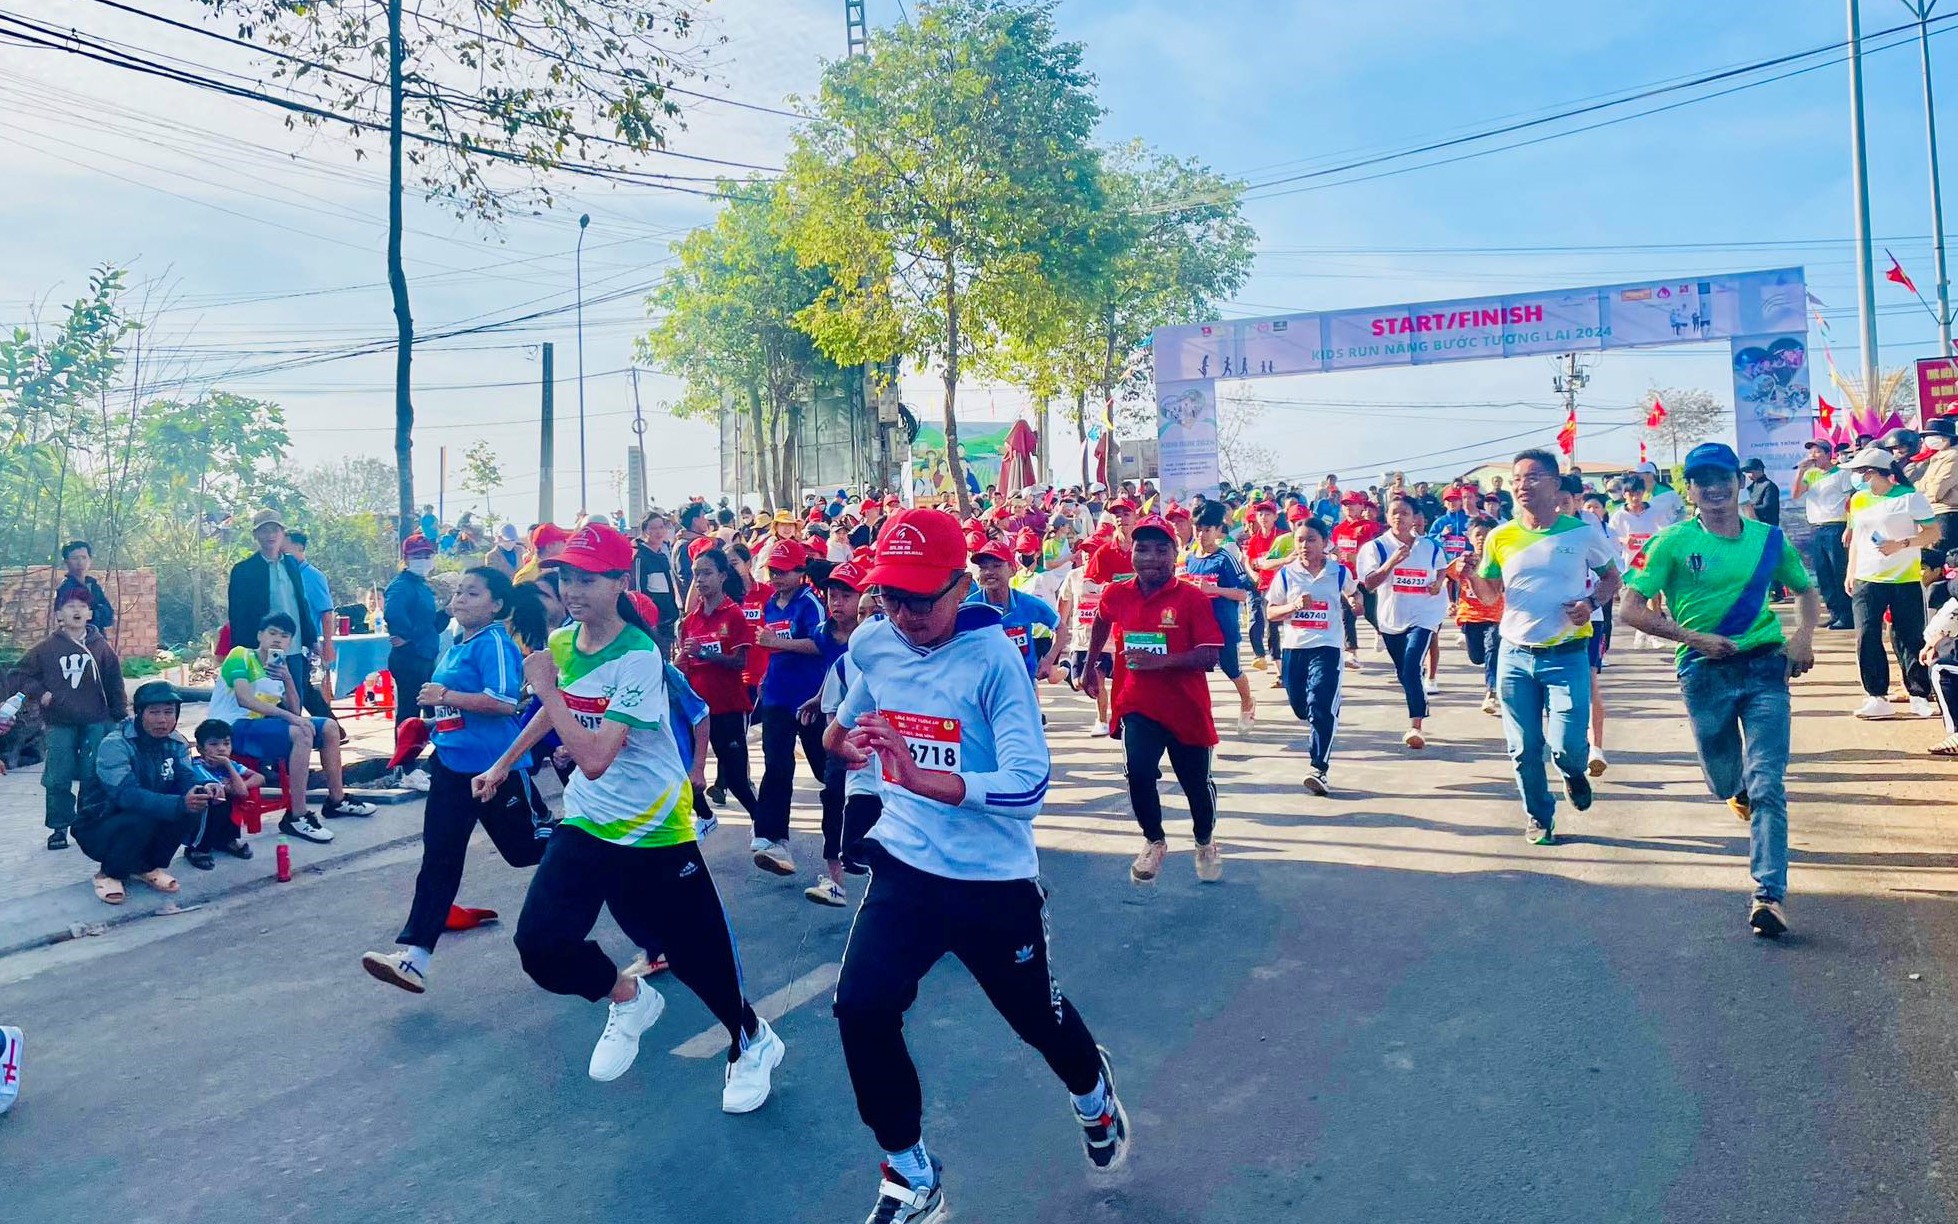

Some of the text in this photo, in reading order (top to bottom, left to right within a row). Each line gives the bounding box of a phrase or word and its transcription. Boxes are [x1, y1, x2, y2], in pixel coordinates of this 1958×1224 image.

[1372, 305, 1543, 336] START/FINISH
[1311, 348, 1344, 360] KIDS
[1348, 345, 1380, 358] RUN
[1434, 335, 1478, 351] BƯỚC
[1482, 331, 1540, 347] TƯƠNG
[1546, 329, 1570, 341] LAI
[1576, 325, 1612, 338] 2024
[1396, 577, 1426, 586] 246737
[1294, 611, 1327, 621] 246740
